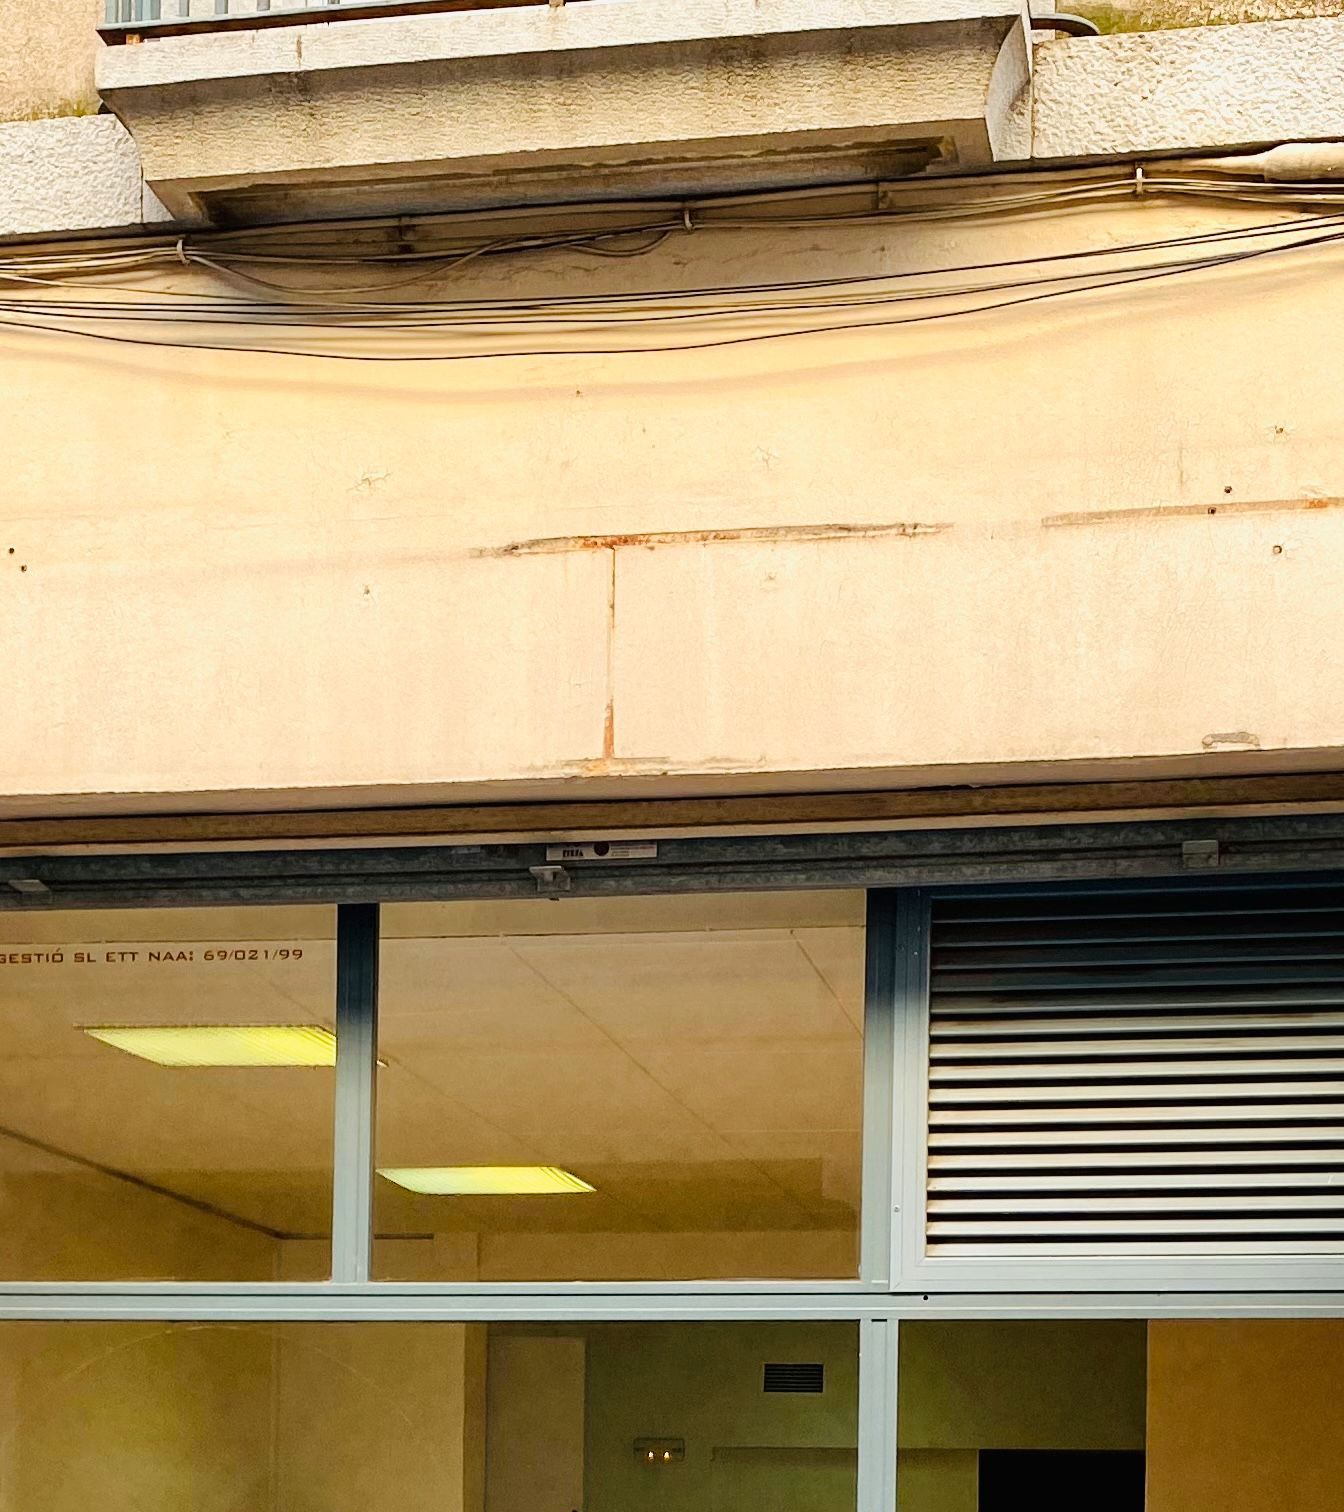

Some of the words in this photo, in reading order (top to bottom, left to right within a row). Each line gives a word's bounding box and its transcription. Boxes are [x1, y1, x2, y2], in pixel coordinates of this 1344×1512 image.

[73, 952, 97, 963] SL
[106, 951, 139, 963] ETT
[148, 951, 194, 962] NAA:
[203, 949, 303, 961] 69/021/99
